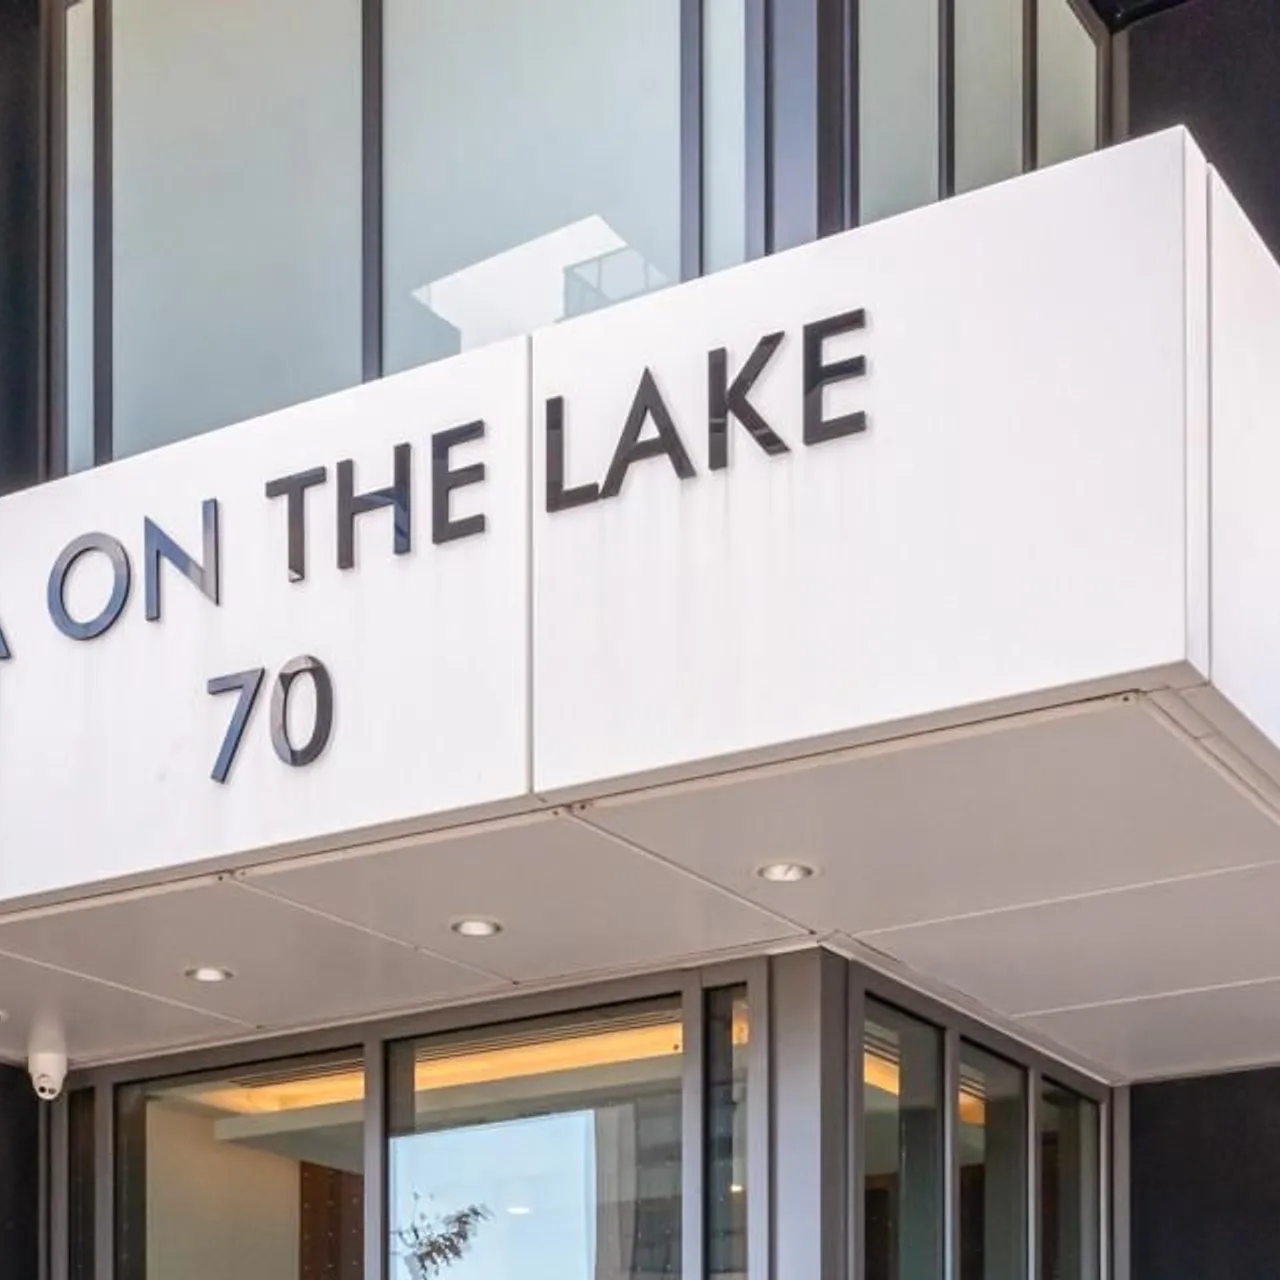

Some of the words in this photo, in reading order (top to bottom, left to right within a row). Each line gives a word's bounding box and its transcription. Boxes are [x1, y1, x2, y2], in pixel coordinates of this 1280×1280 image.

[46, 496, 221, 642] ON
[265, 418, 486, 584] THE
[543, 306, 868, 513] LAKE
[207, 654, 337, 786] 70
